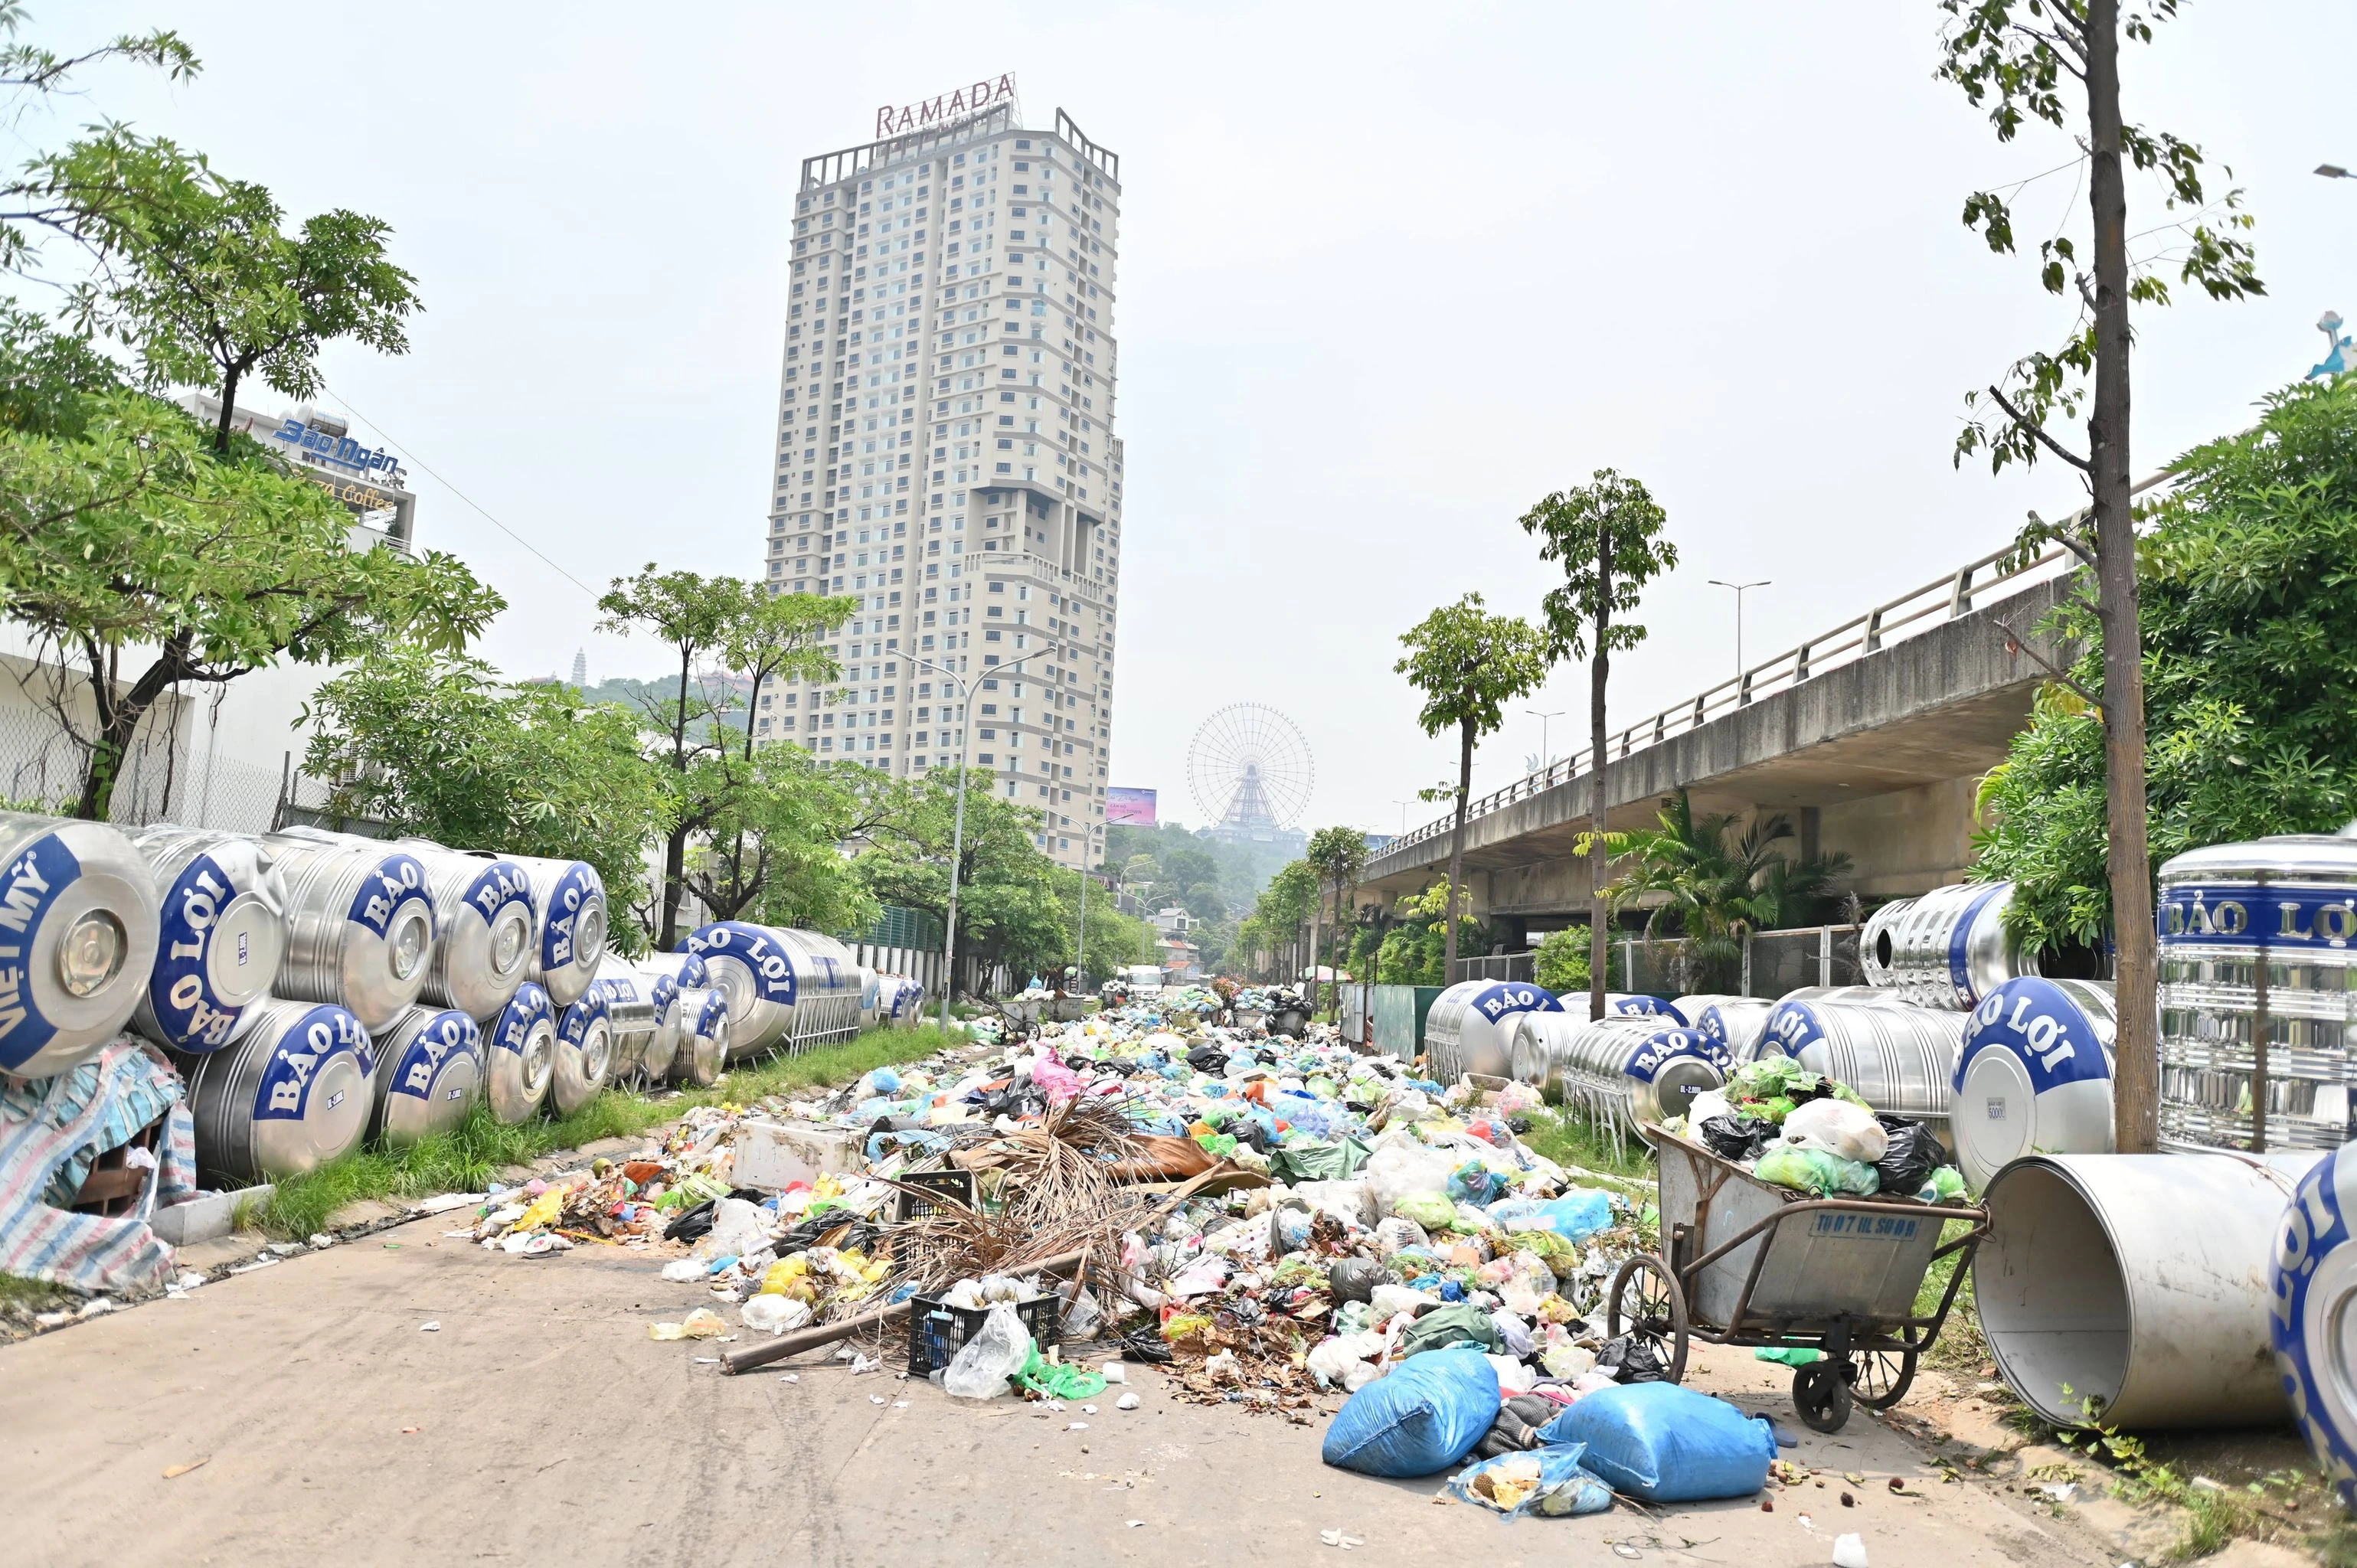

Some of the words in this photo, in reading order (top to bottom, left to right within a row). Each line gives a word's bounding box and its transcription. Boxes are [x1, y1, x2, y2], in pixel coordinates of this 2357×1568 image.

[876, 74, 1014, 139] RAMADA
[335, 435, 399, 475] Ngân
[342, 484, 394, 512] Coffee
[170, 871, 226, 962] LỢI
[364, 862, 418, 929] BẢO
[476, 867, 526, 916] BẢO
[2159, 890, 2248, 936] BẢO
[550, 887, 580, 965] BẢO
[602, 980, 618, 1000] ẢO
[746, 936, 790, 993] LỢI
[170, 974, 235, 1045] BẢO
[505, 989, 544, 1049] BẢO
[567, 988, 601, 1042] BẢO
[655, 979, 675, 1024] BẢO
[1483, 988, 1534, 1017] BẢO
[1768, 1007, 1809, 1050] LỢI
[405, 1019, 460, 1093] BẢO
[1635, 1032, 1688, 1075] BẢO
[2006, 996, 2075, 1073] LỢI
[269, 1022, 333, 1113] BẢO
[2268, 1174, 2336, 1331] LỢI
